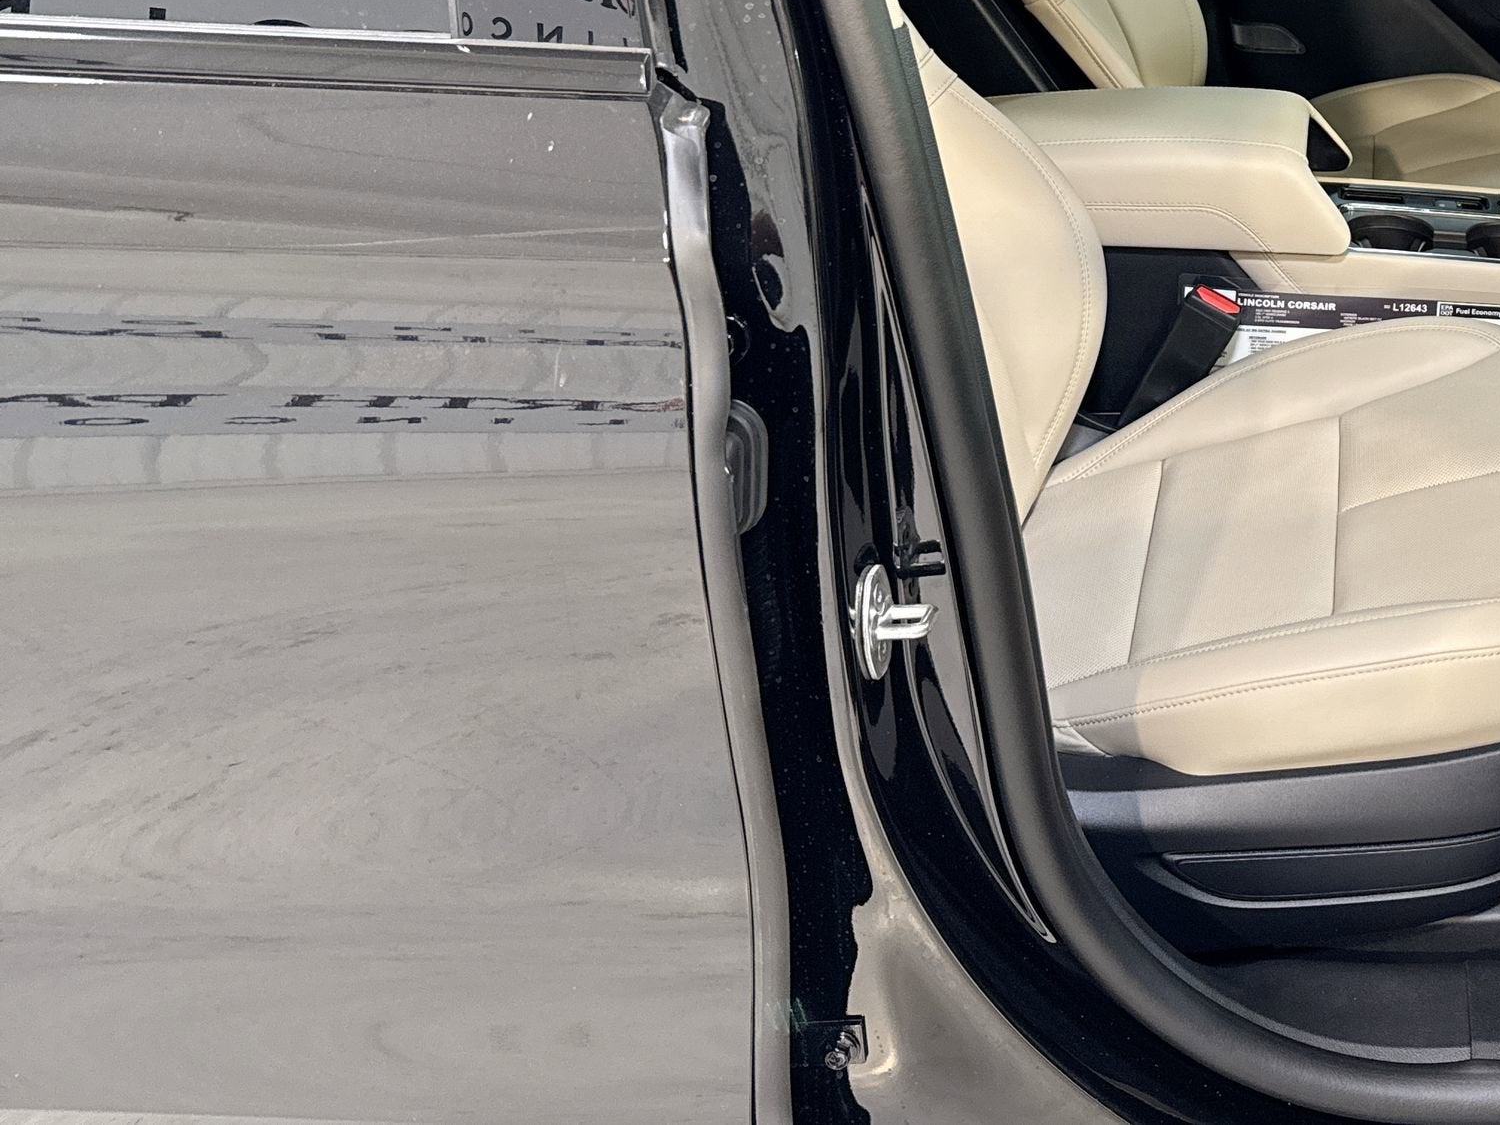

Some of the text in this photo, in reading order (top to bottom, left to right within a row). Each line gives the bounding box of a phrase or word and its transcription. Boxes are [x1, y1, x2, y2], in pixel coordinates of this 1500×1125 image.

[1237, 298, 1337, 311] LINCOLN CORSAIR
[1392, 303, 1428, 313] L12643
[1455, 307, 1470, 315] Fuel
